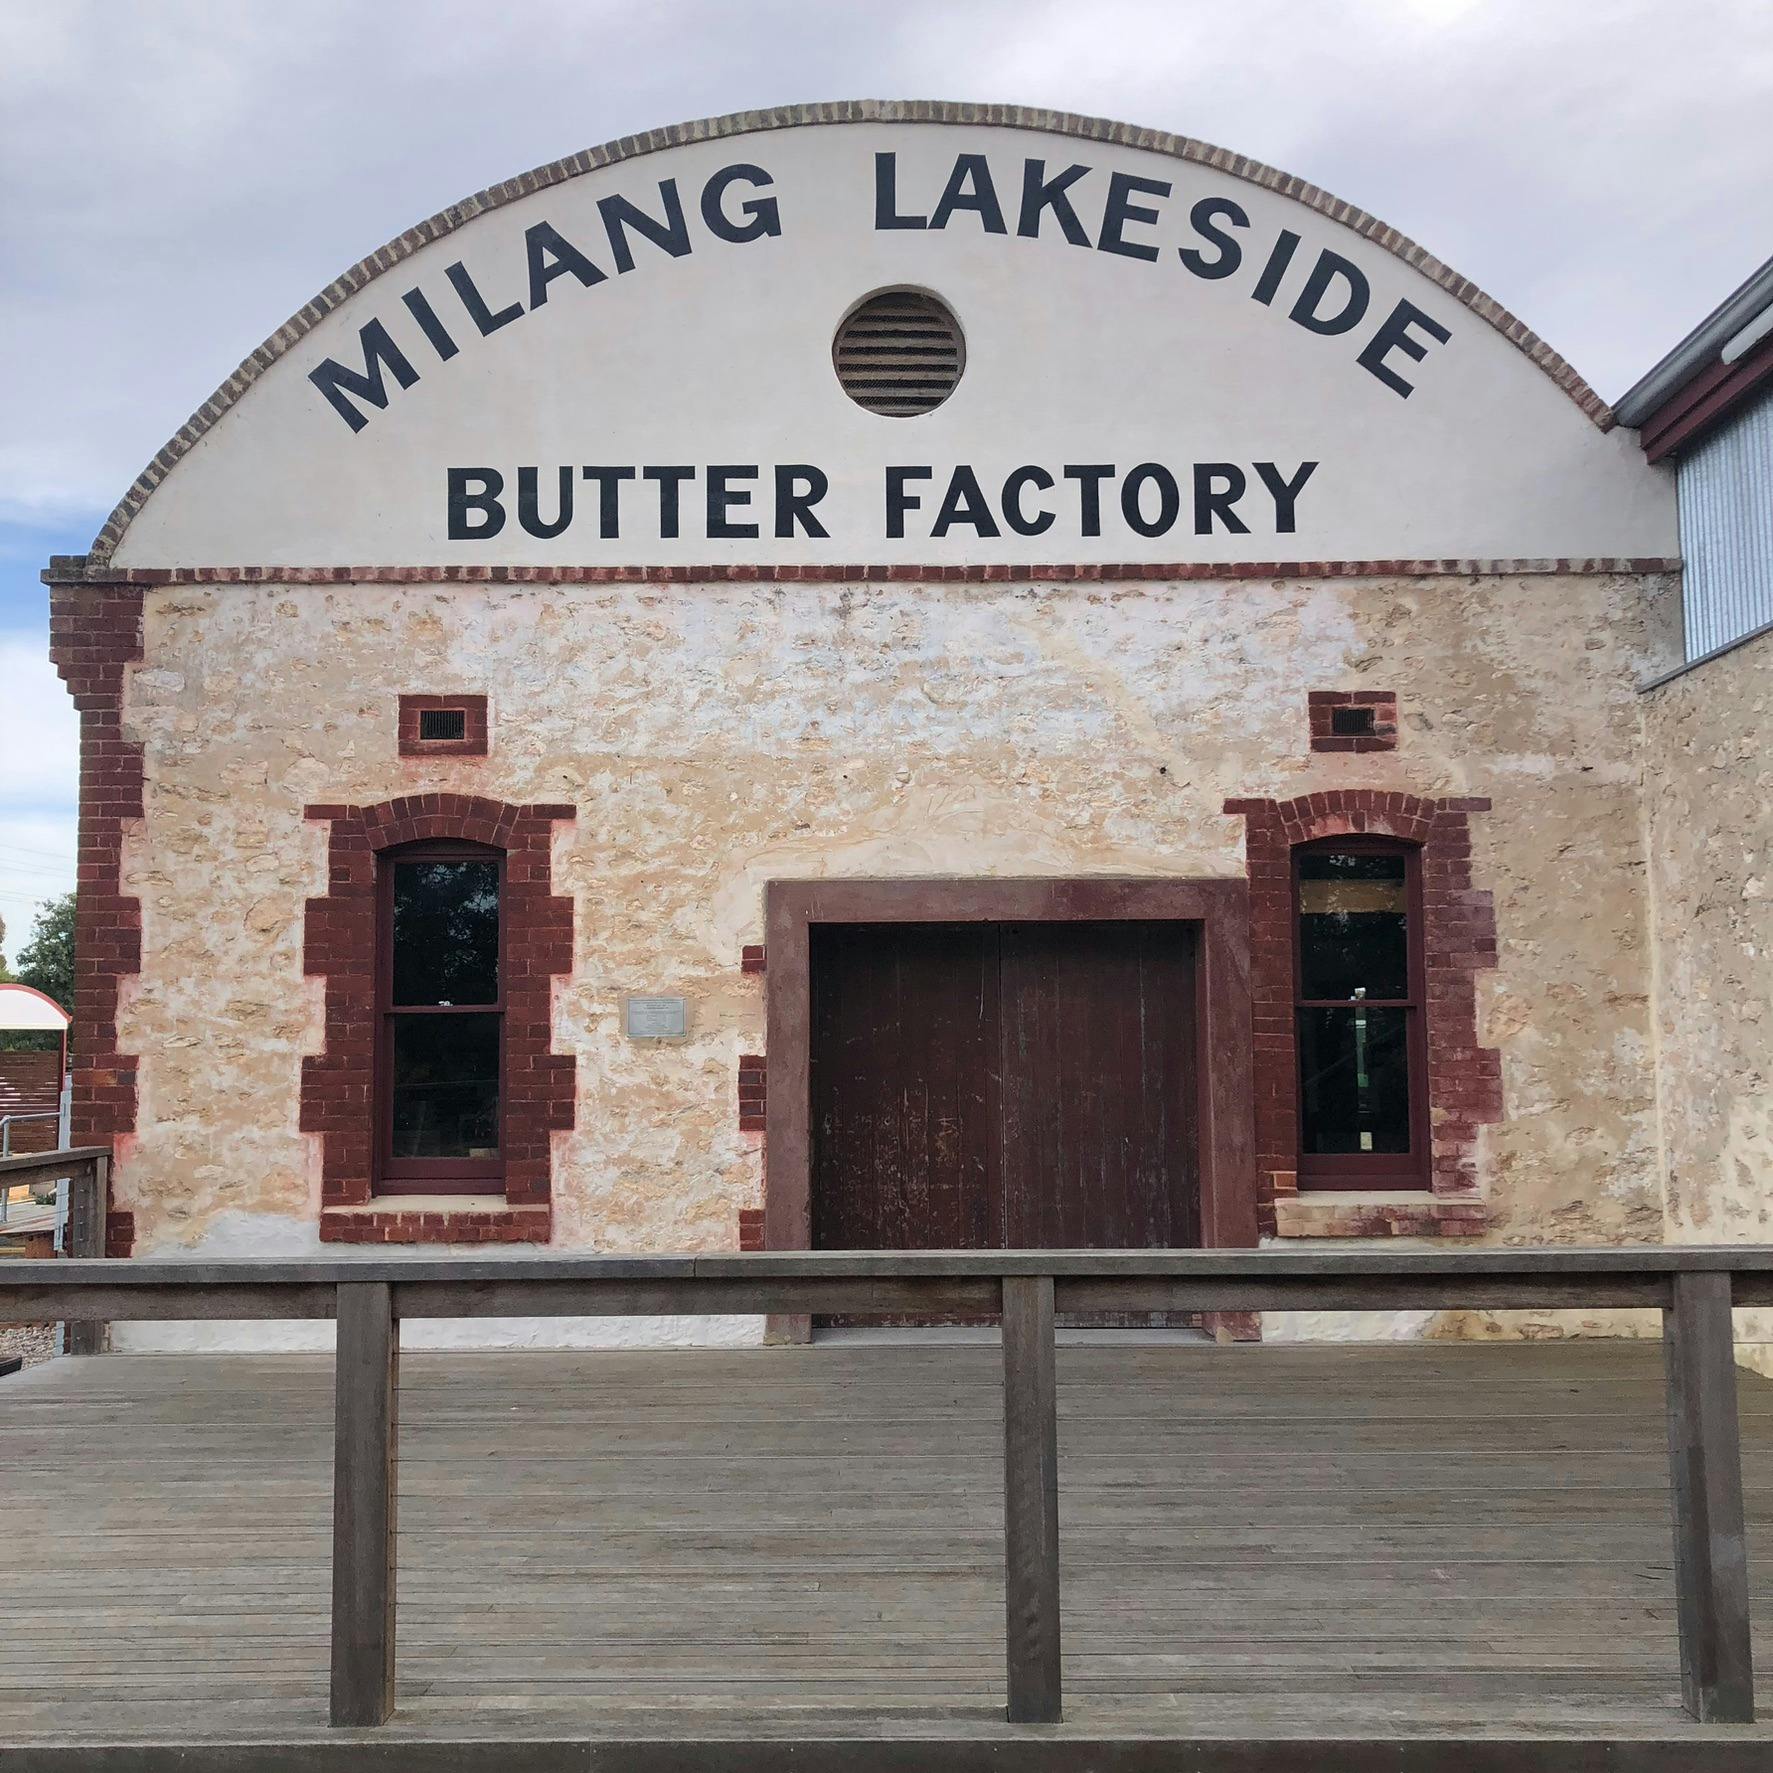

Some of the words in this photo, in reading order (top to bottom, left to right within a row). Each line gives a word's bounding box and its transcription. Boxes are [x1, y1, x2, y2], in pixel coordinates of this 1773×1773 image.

[308, 164, 781, 433] MILANG
[875, 152, 1452, 399] LAKESIDE
[448, 465, 830, 540] BUTTER
[886, 462, 1319, 537] FACTORY
